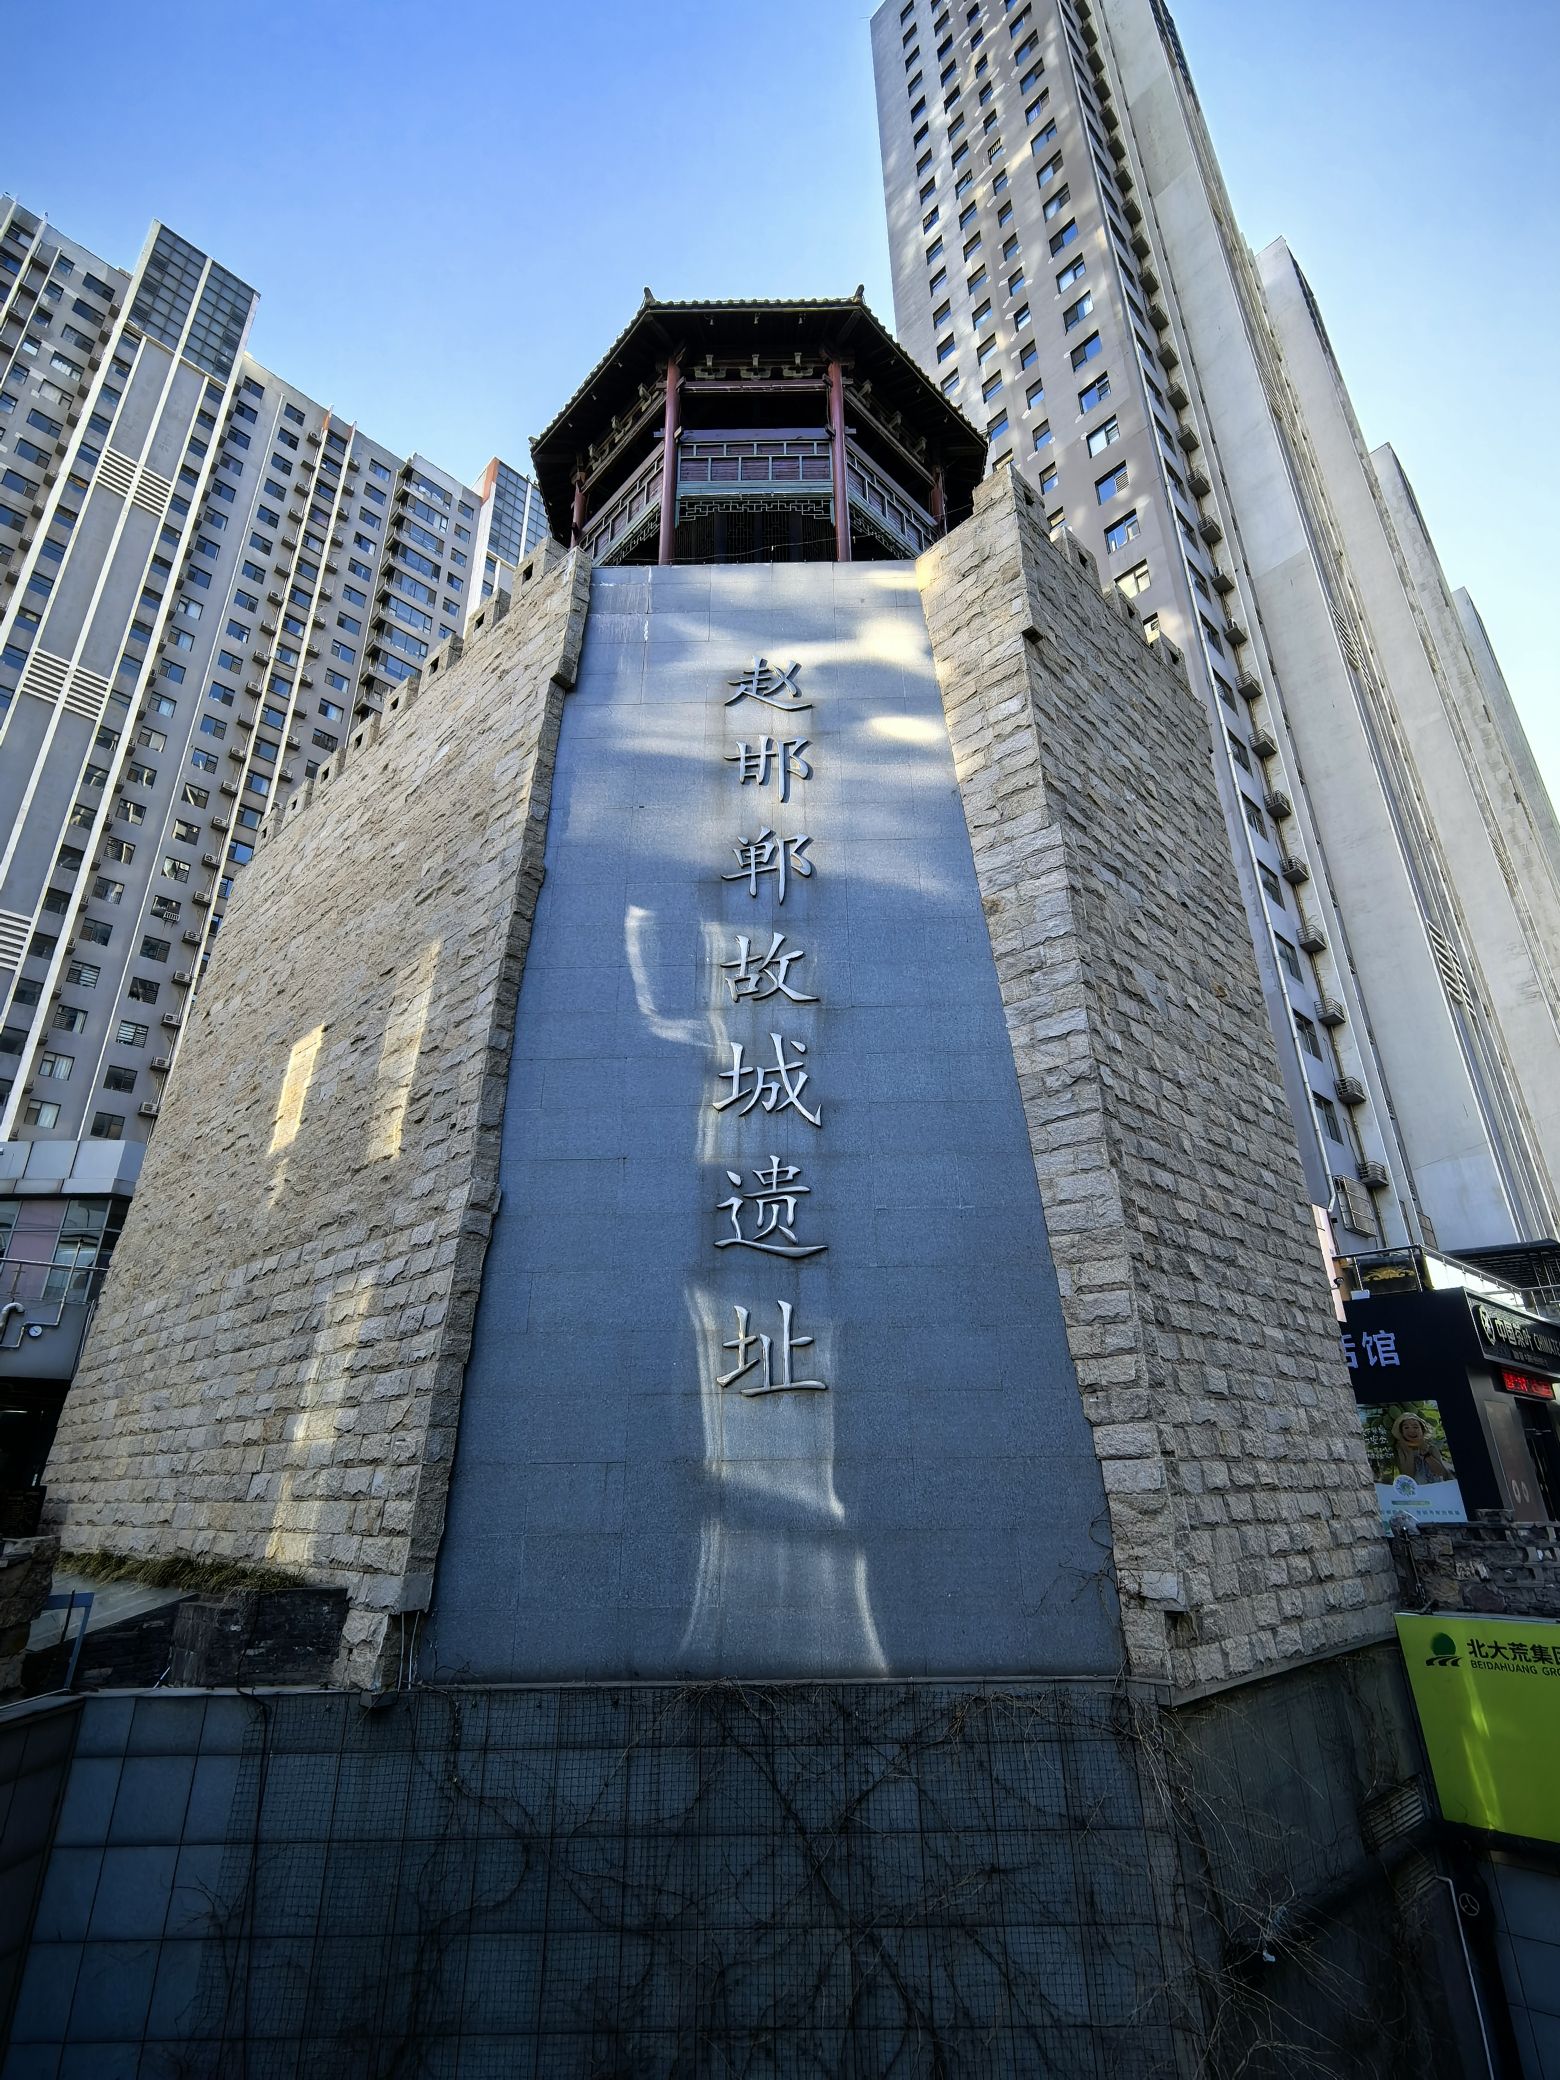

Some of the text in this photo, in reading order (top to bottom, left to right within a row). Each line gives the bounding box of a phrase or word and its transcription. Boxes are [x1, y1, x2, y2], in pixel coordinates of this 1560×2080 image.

[711, 655, 829, 1399] 赵邯郸故城遗址
[1470, 1659, 1538, 1675] BEIDAHUANG
